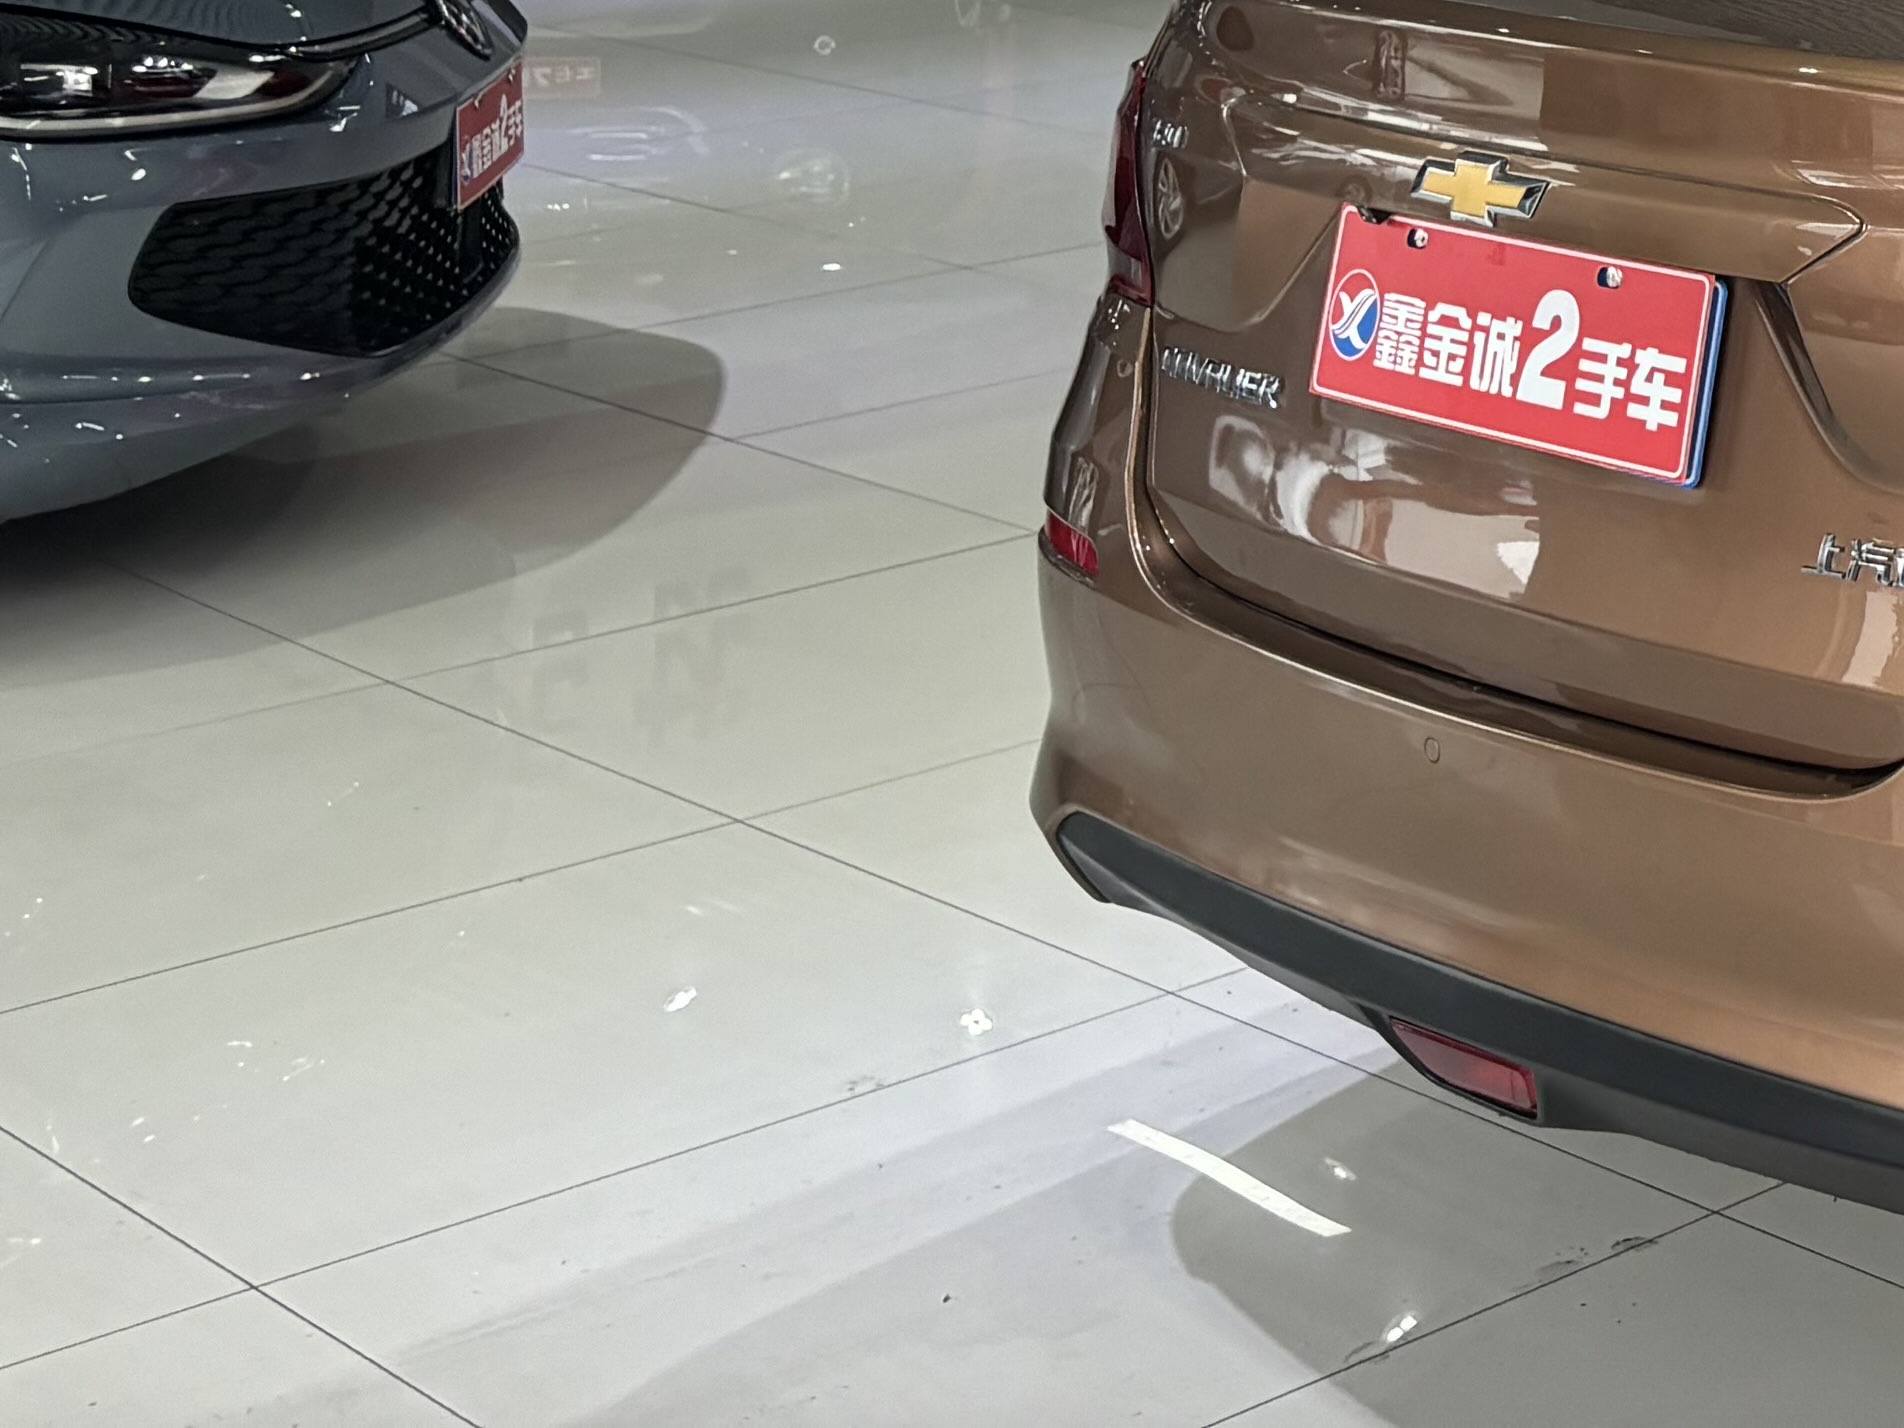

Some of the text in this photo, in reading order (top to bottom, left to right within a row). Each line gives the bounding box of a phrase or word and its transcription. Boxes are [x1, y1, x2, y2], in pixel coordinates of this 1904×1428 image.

[471, 93, 523, 179] 鑫金诚2手车
[1371, 288, 1690, 434] 鑫金诚2手车
